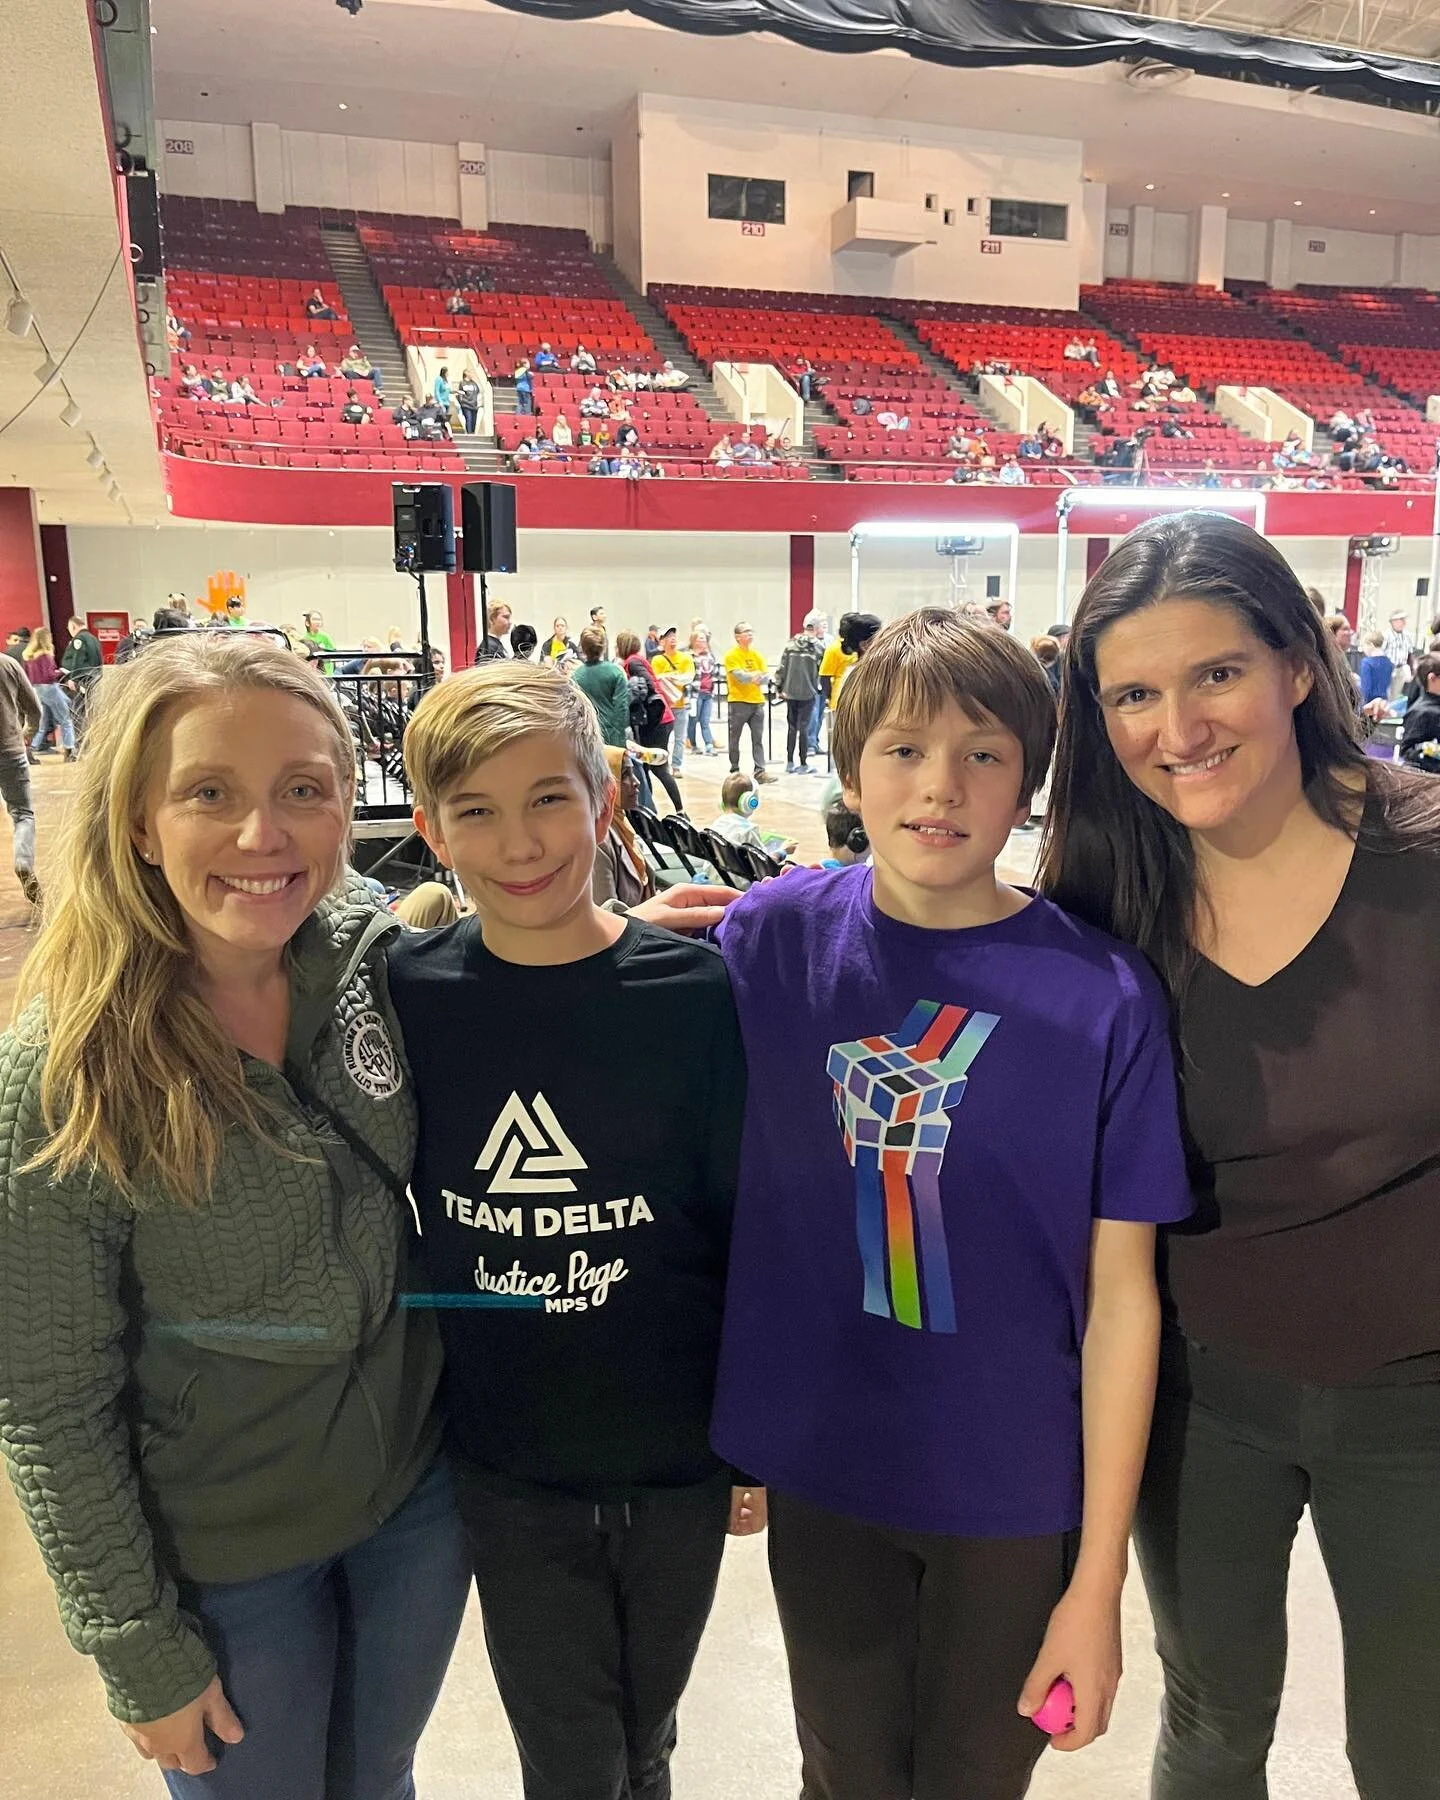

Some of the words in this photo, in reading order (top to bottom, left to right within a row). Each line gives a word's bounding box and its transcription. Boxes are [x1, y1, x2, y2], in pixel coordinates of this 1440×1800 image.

[166, 140, 193, 154] 208
[460, 161, 485, 175] 209
[743, 222, 764, 236] 210
[982, 241, 1000, 254] 211
[353, 1072, 372, 1090] CITY
[441, 1189, 523, 1237] TEAM
[534, 1195, 655, 1237] DELTA
[474, 1255, 562, 1296] Justice
[567, 1250, 629, 1307] Page
[544, 1296, 589, 1313] MPS
